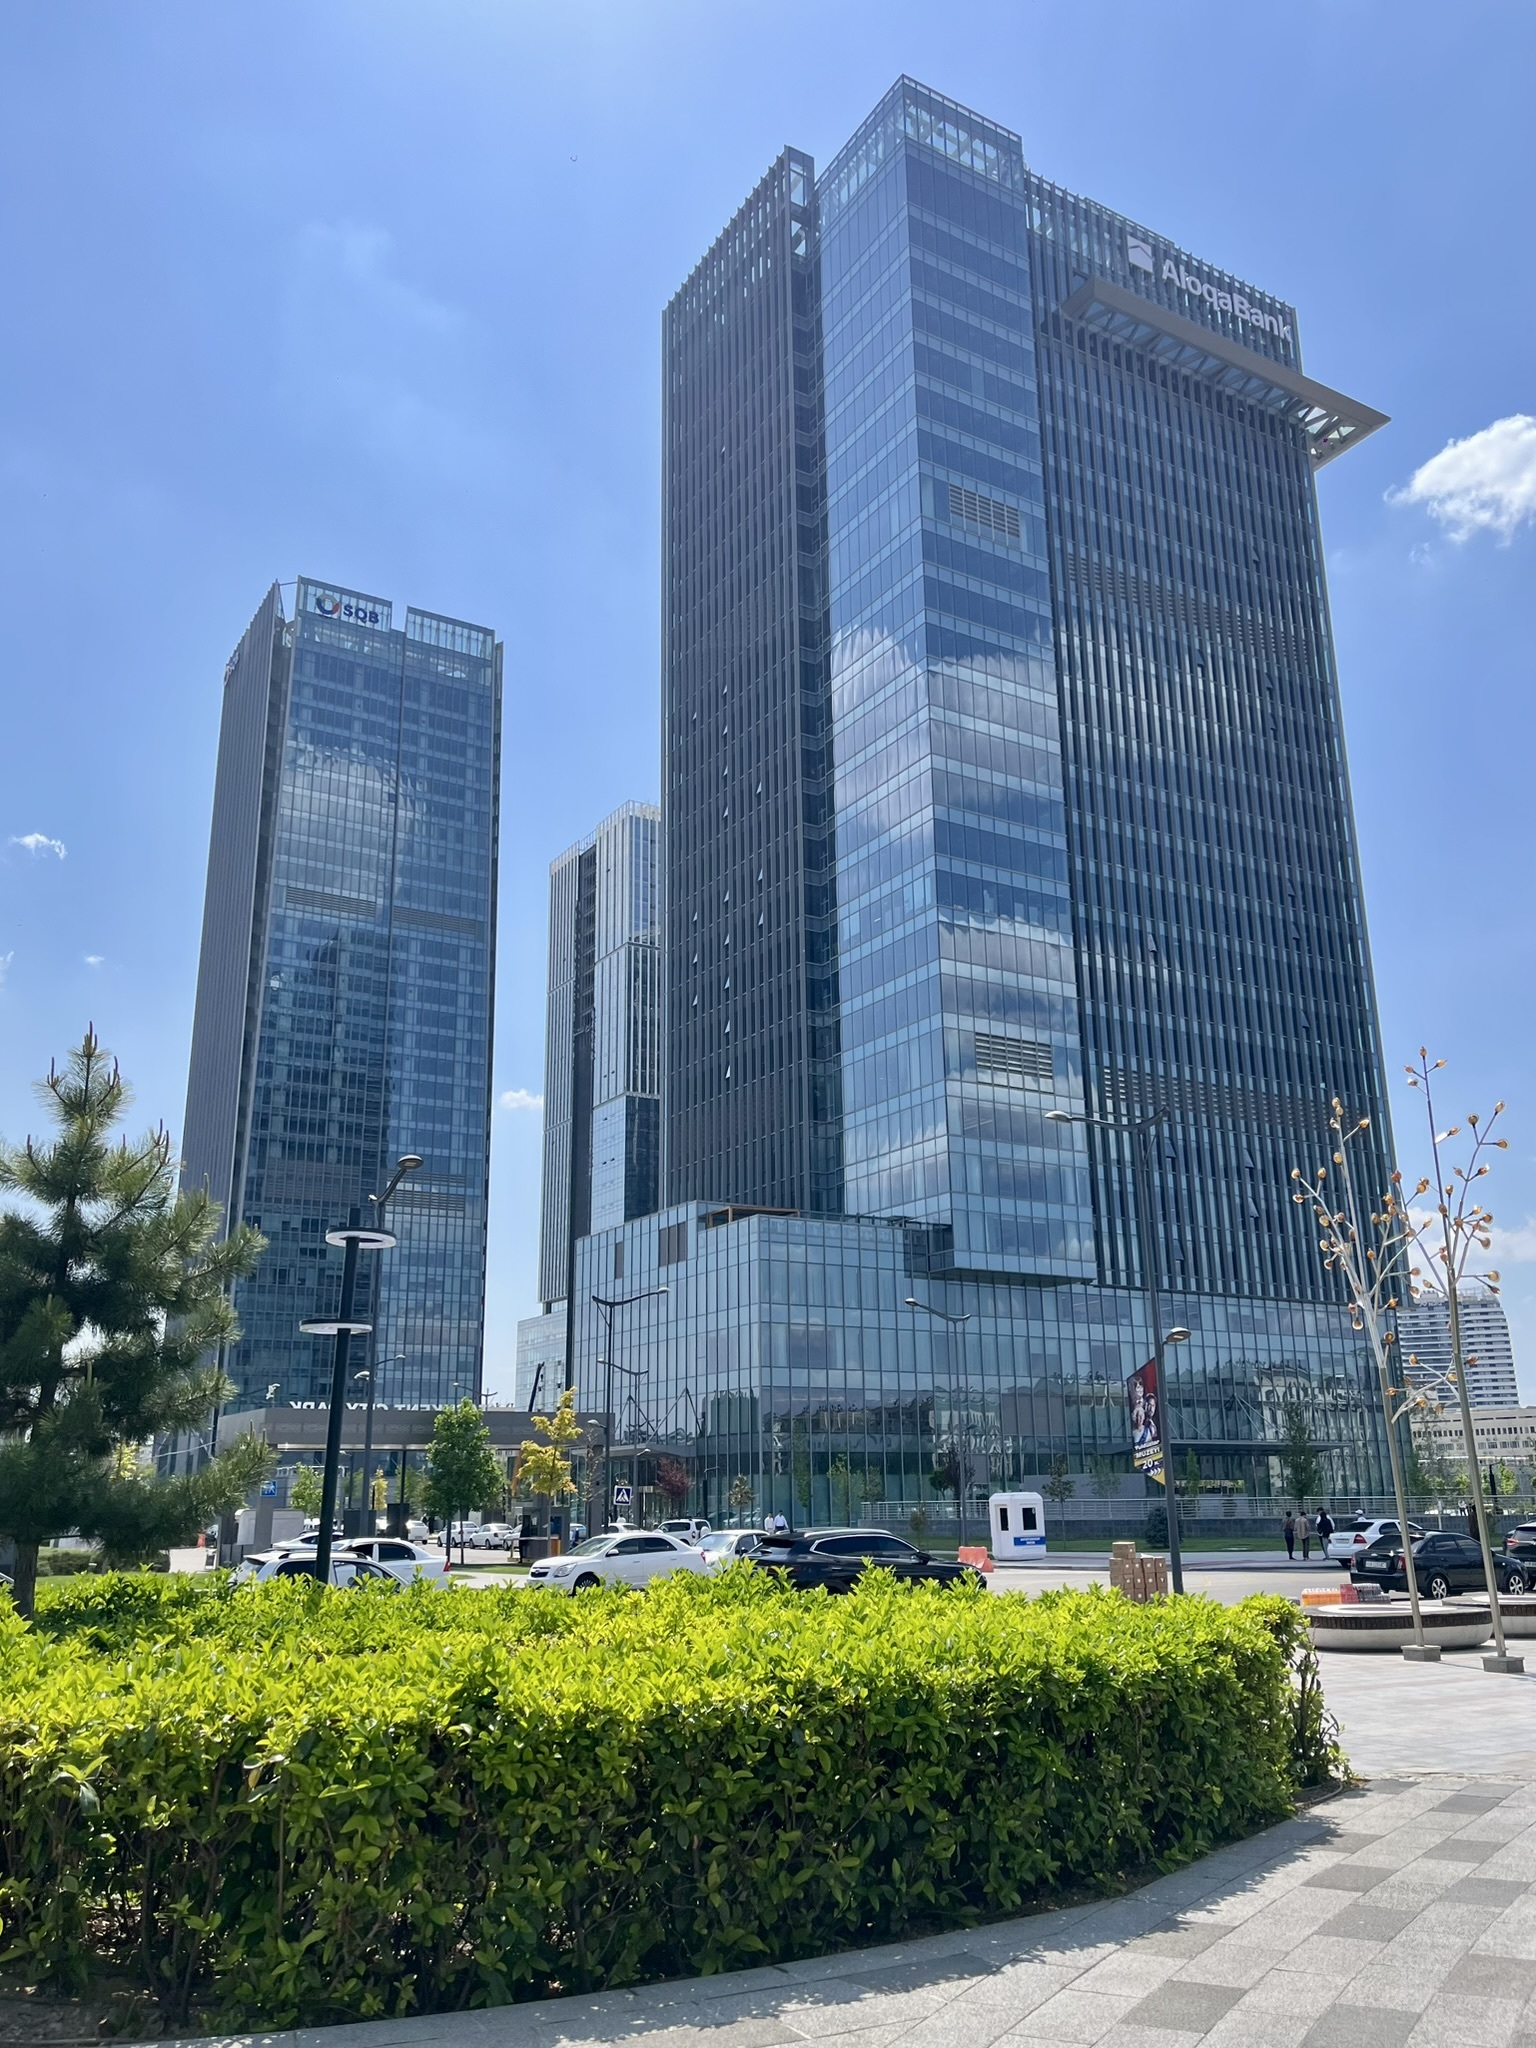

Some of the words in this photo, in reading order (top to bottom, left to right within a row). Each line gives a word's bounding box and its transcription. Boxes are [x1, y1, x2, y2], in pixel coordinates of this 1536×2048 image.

[1162, 259, 1292, 343] AloqaBank
[343, 604, 379, 624] SQB
[1142, 1459, 1153, 1469] 20
